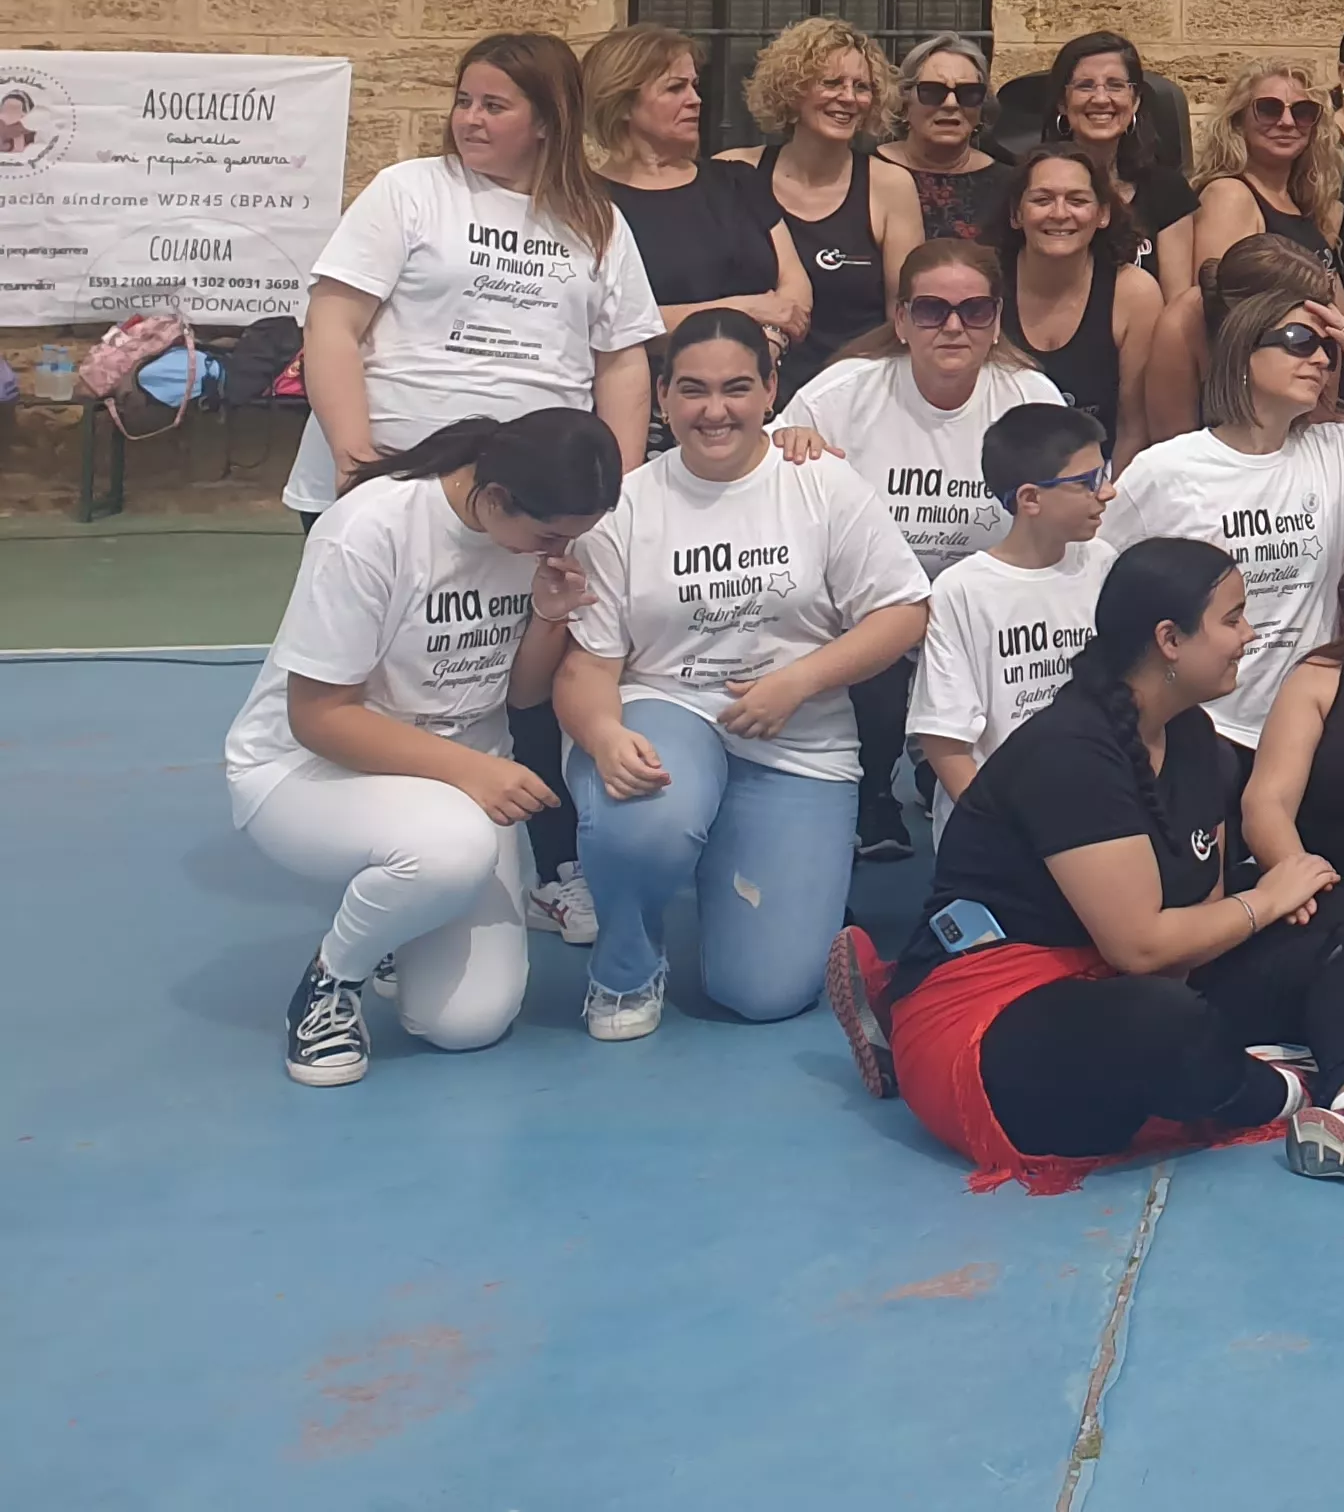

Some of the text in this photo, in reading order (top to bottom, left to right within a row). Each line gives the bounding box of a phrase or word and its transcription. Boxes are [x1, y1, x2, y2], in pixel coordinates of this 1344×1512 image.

[142, 88, 276, 122] ASOCIACIÓN
[167, 132, 241, 145] Gabriella
[111, 153, 291, 175] mi pequeña guerrera
[62, 192, 149, 207] síndrome
[157, 193, 223, 207] WDR45
[149, 235, 233, 264] COLABORA
[468, 222, 570, 259] una entre
[469, 250, 544, 277] un millón
[89, 276, 299, 290] ES93 2100 2034 1302 0031 3698
[473, 274, 543, 296] Gabriella
[91, 293, 180, 310] CONCEPTO
[887, 468, 994, 499] una entre
[916, 504, 969, 524] millón
[1222, 508, 1315, 538] una entre
[673, 542, 789, 575] una entre
[1255, 539, 1299, 562] millón
[678, 574, 763, 603] un millón
[425, 589, 483, 624] una
[693, 600, 763, 624] Gabriella
[425, 625, 511, 653] un millón
[998, 621, 1093, 657] una entre
[432, 651, 508, 678] Gabriella
[1004, 666, 1023, 684] un
